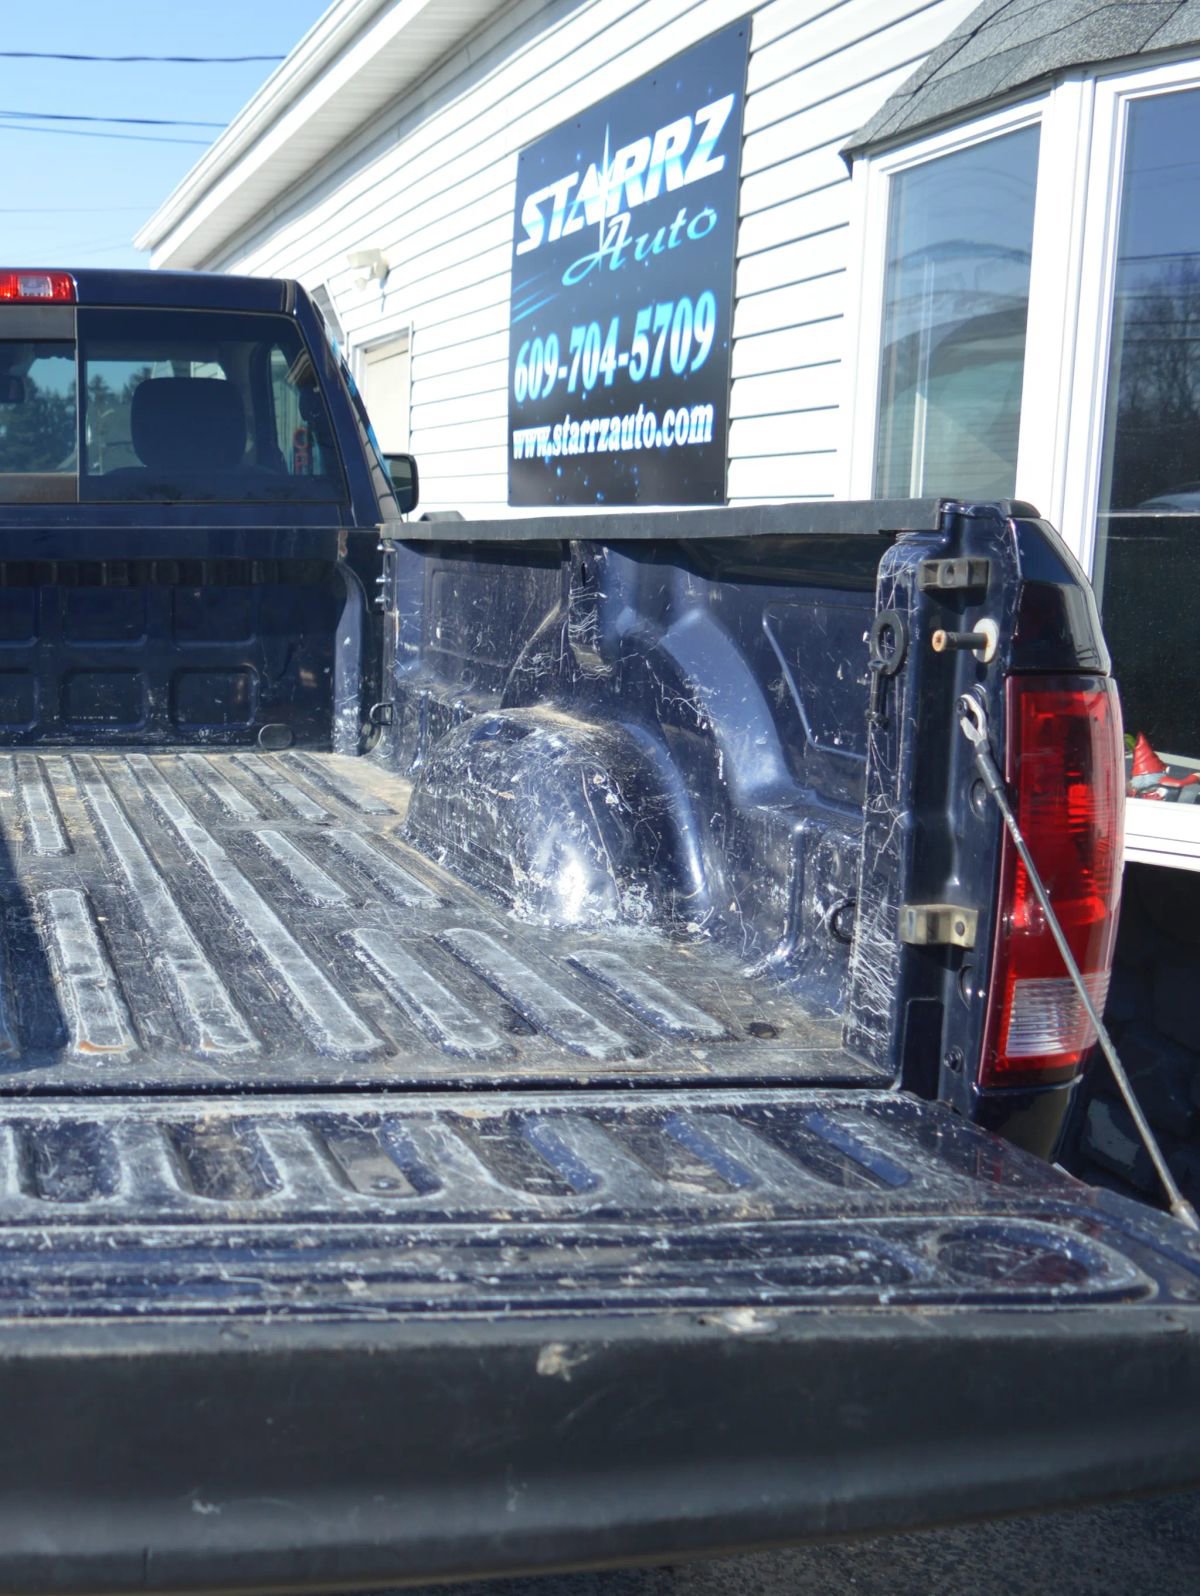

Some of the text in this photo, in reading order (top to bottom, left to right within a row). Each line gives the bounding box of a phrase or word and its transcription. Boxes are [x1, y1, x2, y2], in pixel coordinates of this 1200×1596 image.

[516, 93, 735, 256] STARRZ
[562, 207, 717, 286] Auto
[514, 290, 716, 403] 609-704-5709
[513, 403, 714, 459] www.starrzauto.com
